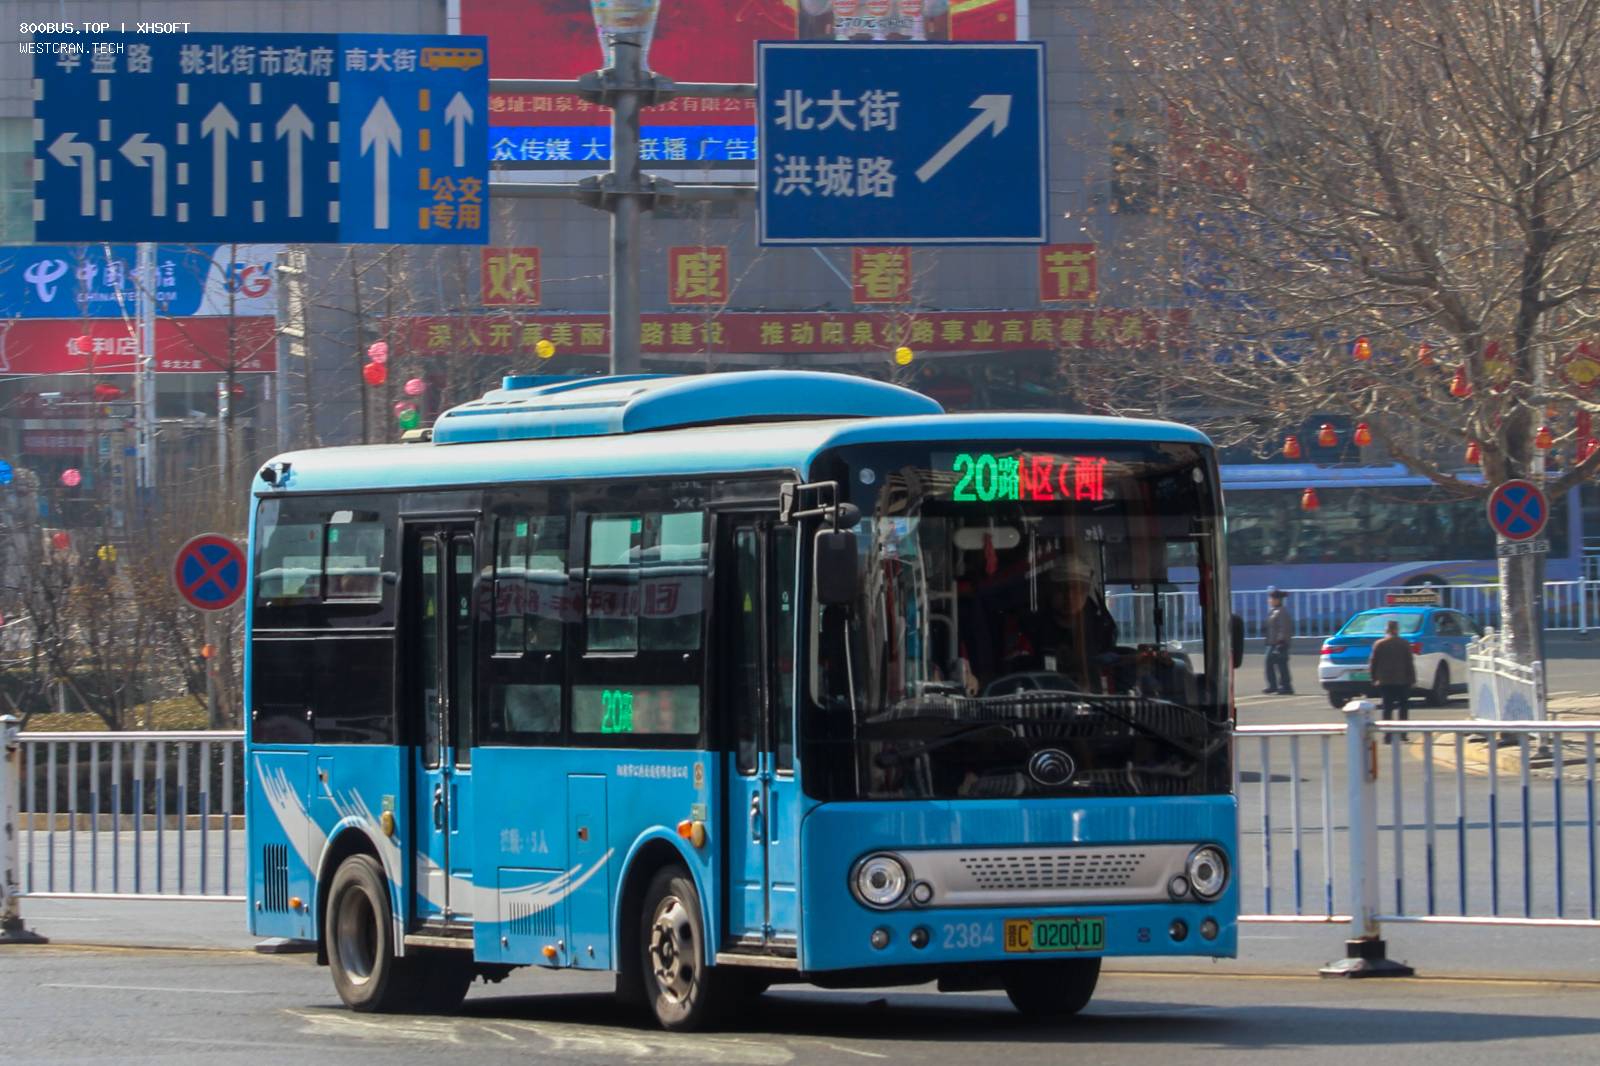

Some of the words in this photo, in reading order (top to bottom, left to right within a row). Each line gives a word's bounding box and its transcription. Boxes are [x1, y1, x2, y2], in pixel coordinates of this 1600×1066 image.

[258, 45, 335, 76] 市政府
[345, 48, 416, 72] 南大街
[774, 89, 900, 131] 北大街
[432, 176, 482, 203] 公交
[773, 153, 897, 198] 洪城路
[431, 202, 481, 230] 专用
[223, 262, 273, 298] 5G
[428, 323, 726, 346] 深入开展美丽路建设
[952, 454, 1020, 501] 20路
[943, 923, 996, 949] 2384
[1037, 923, 1103, 946] 02001D
